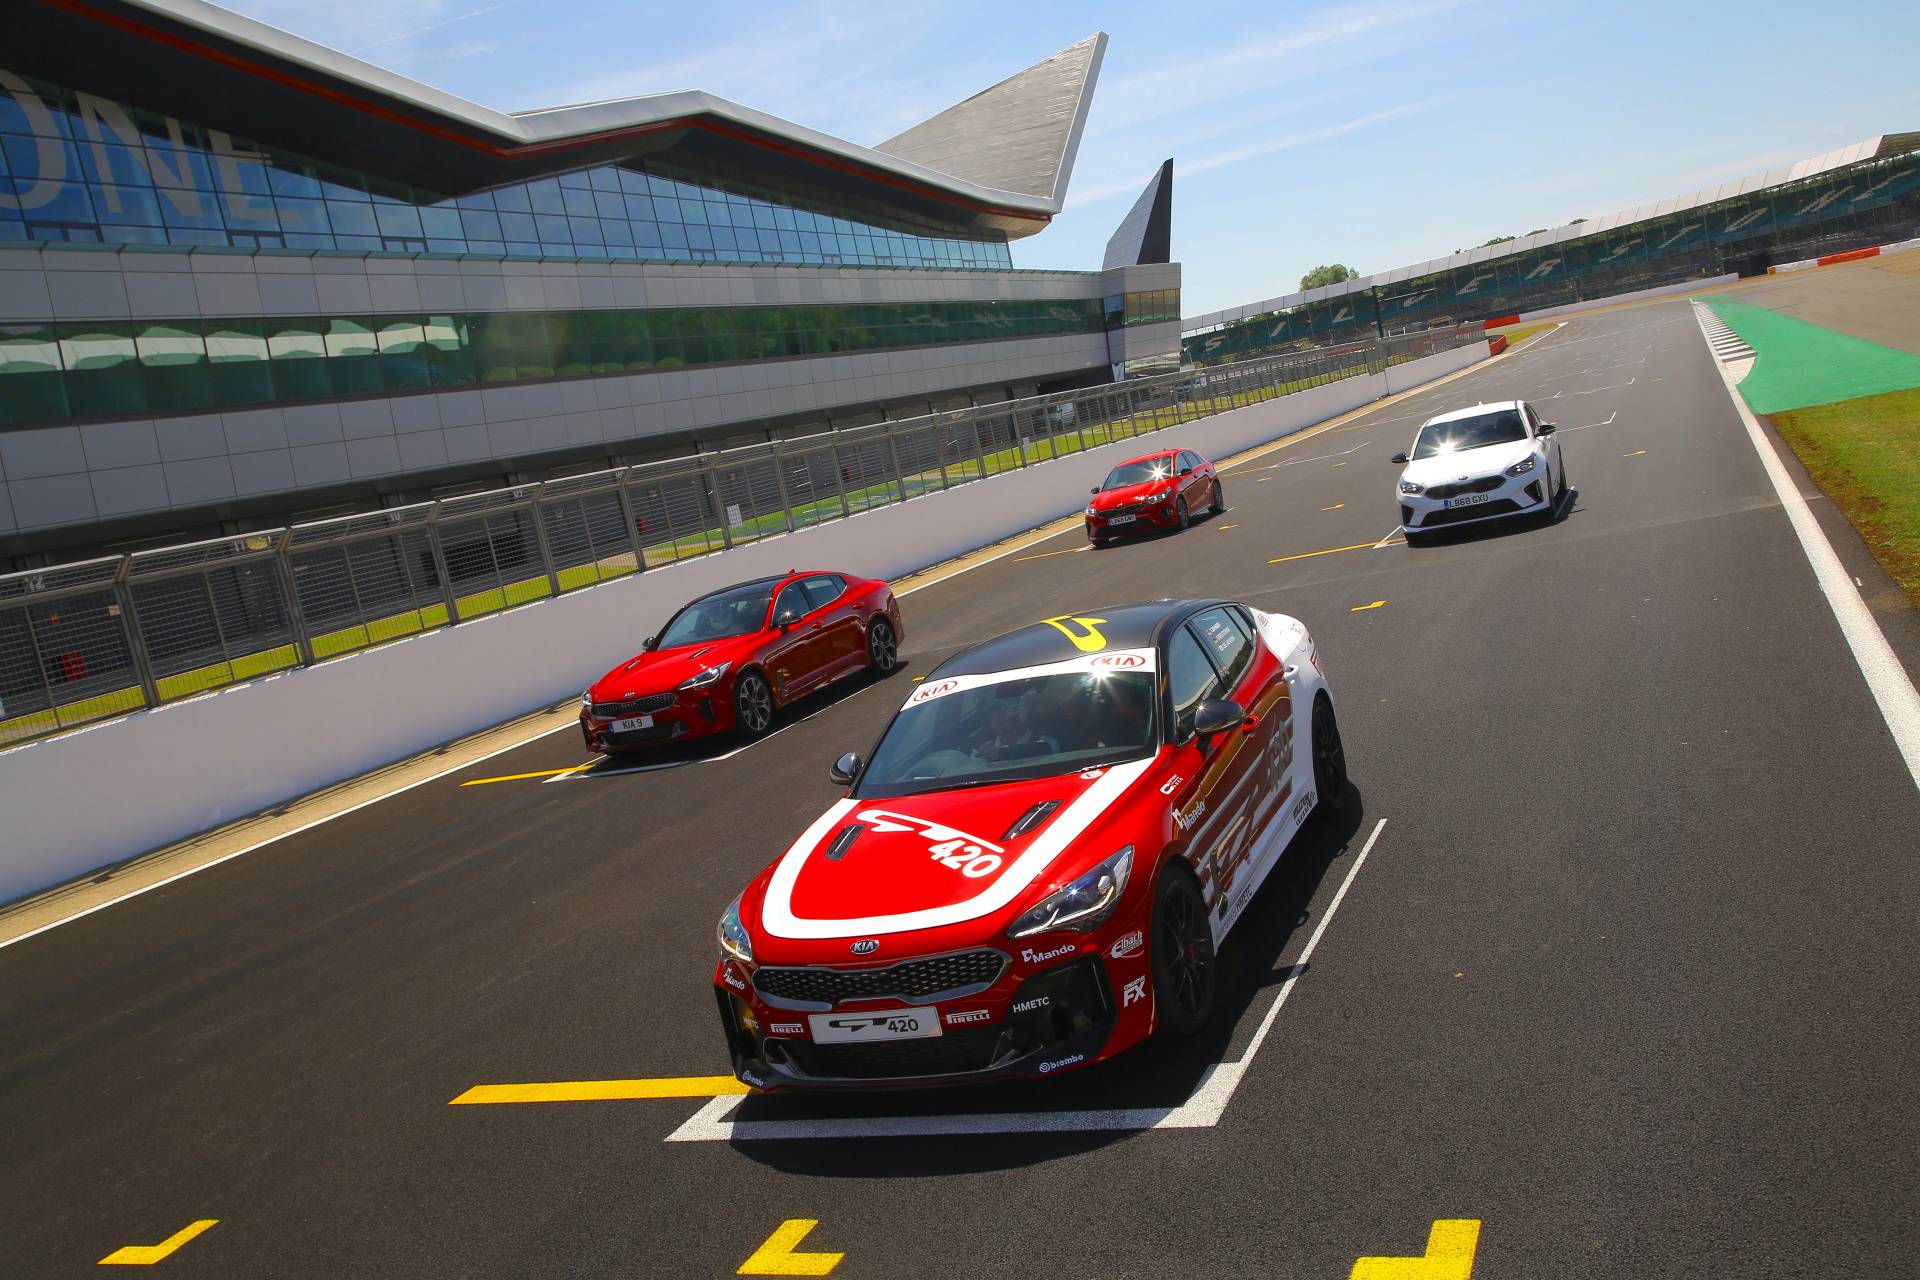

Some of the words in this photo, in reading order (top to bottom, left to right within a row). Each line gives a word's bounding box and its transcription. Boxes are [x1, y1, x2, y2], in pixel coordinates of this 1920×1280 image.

[919, 683, 952, 699] KIA
[622, 719, 636, 730] KIA
[636, 718, 643, 728] 9
[928, 839, 1002, 878] 420
[853, 941, 875, 952] KIA
[1033, 944, 1076, 963] Mando
[725, 974, 745, 990] Mando
[1123, 980, 1146, 1008] FX
[1012, 996, 1050, 1013] HMETC
[946, 1009, 990, 1024] PIRELLI
[769, 1023, 804, 1034] PIRELLI
[887, 1018, 919, 1034] 420
